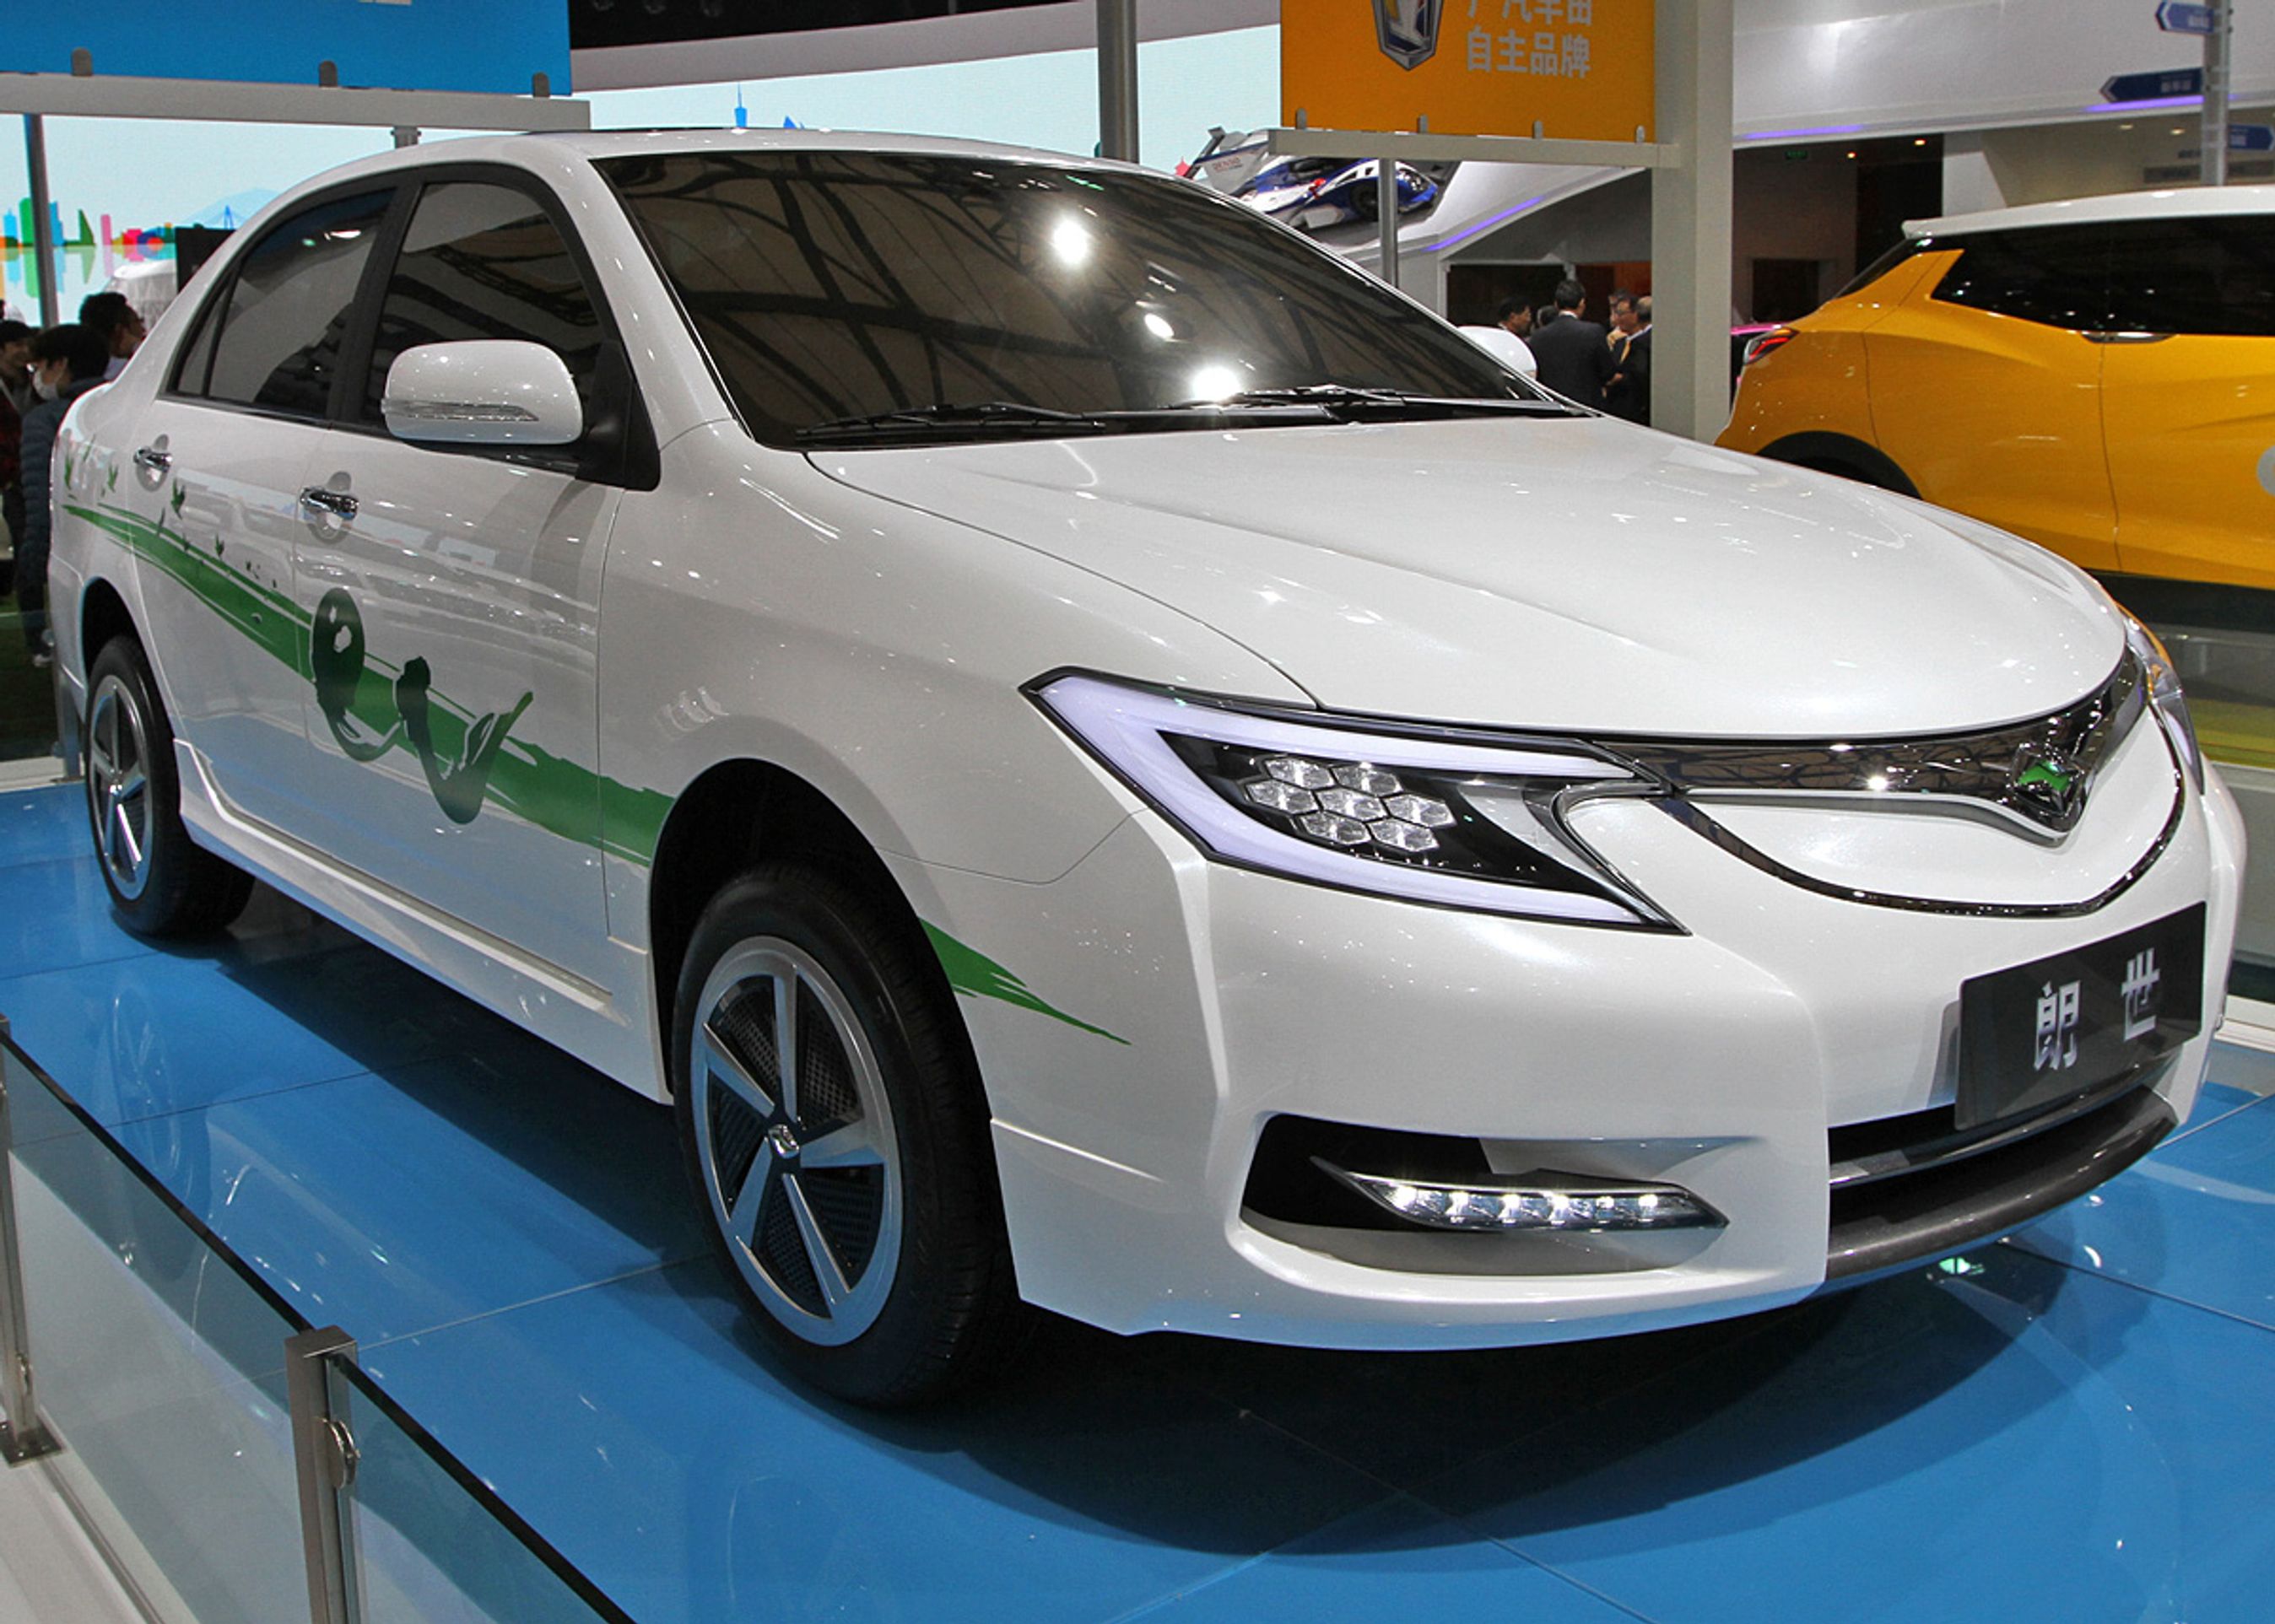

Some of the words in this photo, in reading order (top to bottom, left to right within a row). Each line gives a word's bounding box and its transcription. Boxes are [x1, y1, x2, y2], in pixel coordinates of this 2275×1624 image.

[1467, 24, 1591, 78] 自主品牌
[2034, 947, 2160, 1071] 朗世
